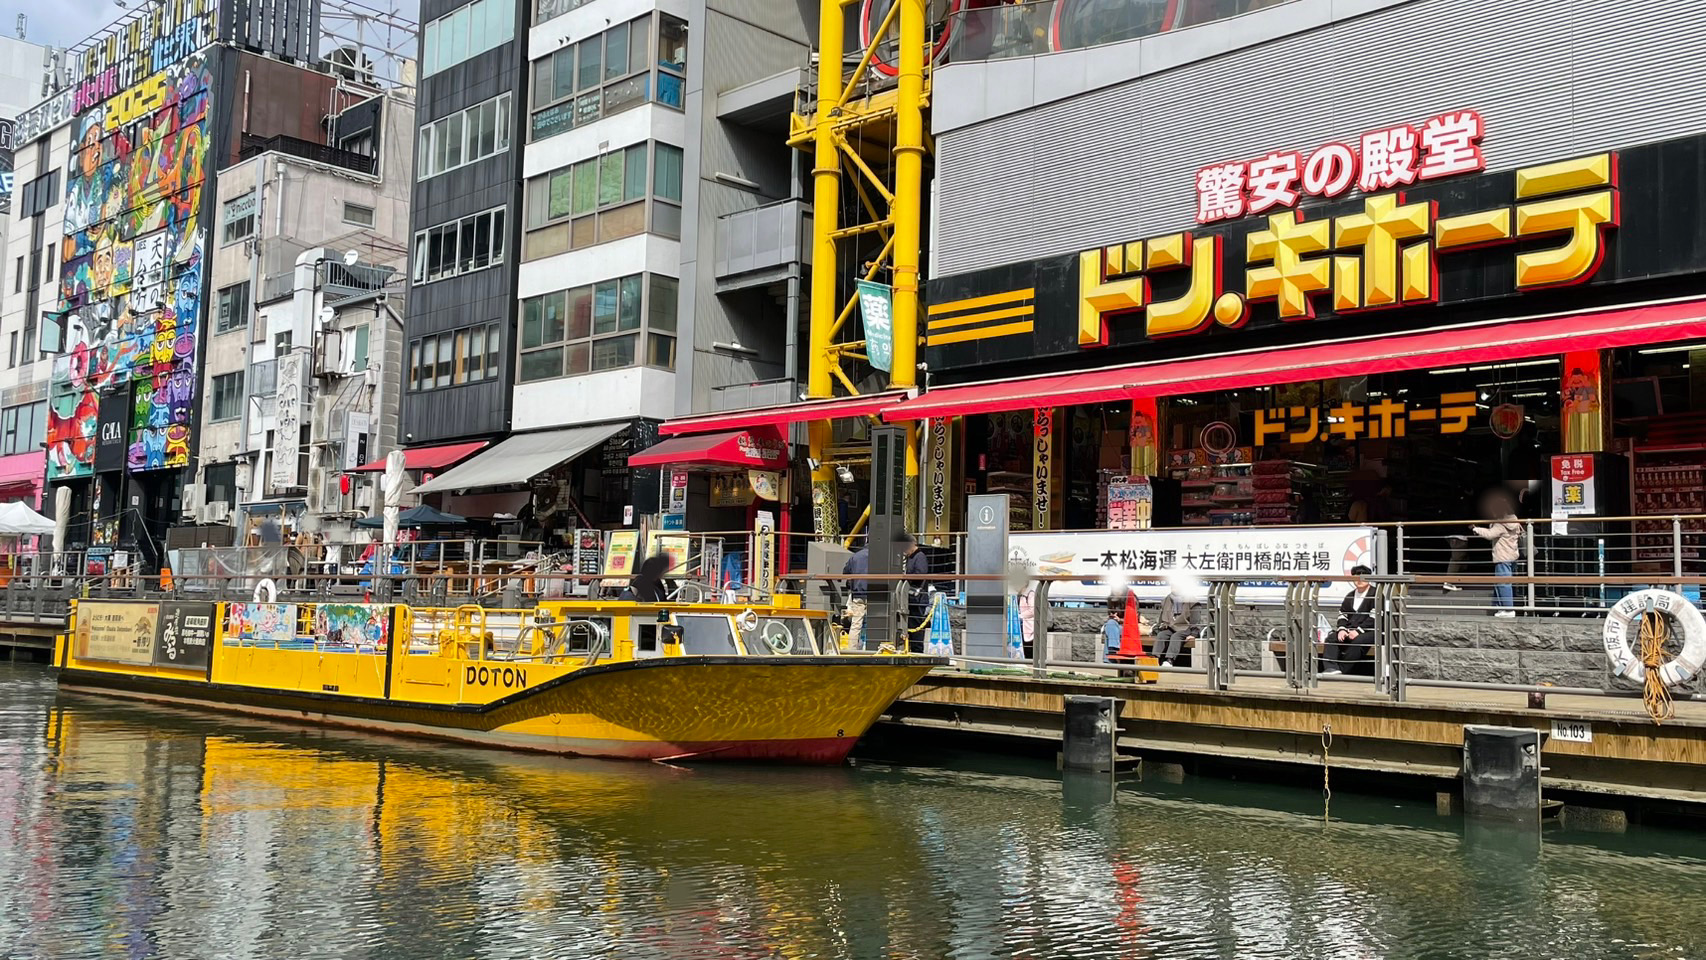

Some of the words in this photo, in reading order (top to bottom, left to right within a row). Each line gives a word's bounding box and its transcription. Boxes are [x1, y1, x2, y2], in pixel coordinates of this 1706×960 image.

[104, 70, 167, 133] 2025
[1195, 109, 1485, 223] 驚安の殿堂
[862, 293, 890, 331] 薬
[1561, 458, 1584, 470] 免税
[1565, 485, 1582, 504] 薬
[1082, 550, 1177, 571] 一本松海運
[1181, 551, 1330, 571] 太左衛門橋船着場
[466, 665, 527, 689] DOTON
[836, 728, 844, 737] 8
[1556, 722, 1585, 739] No.103
